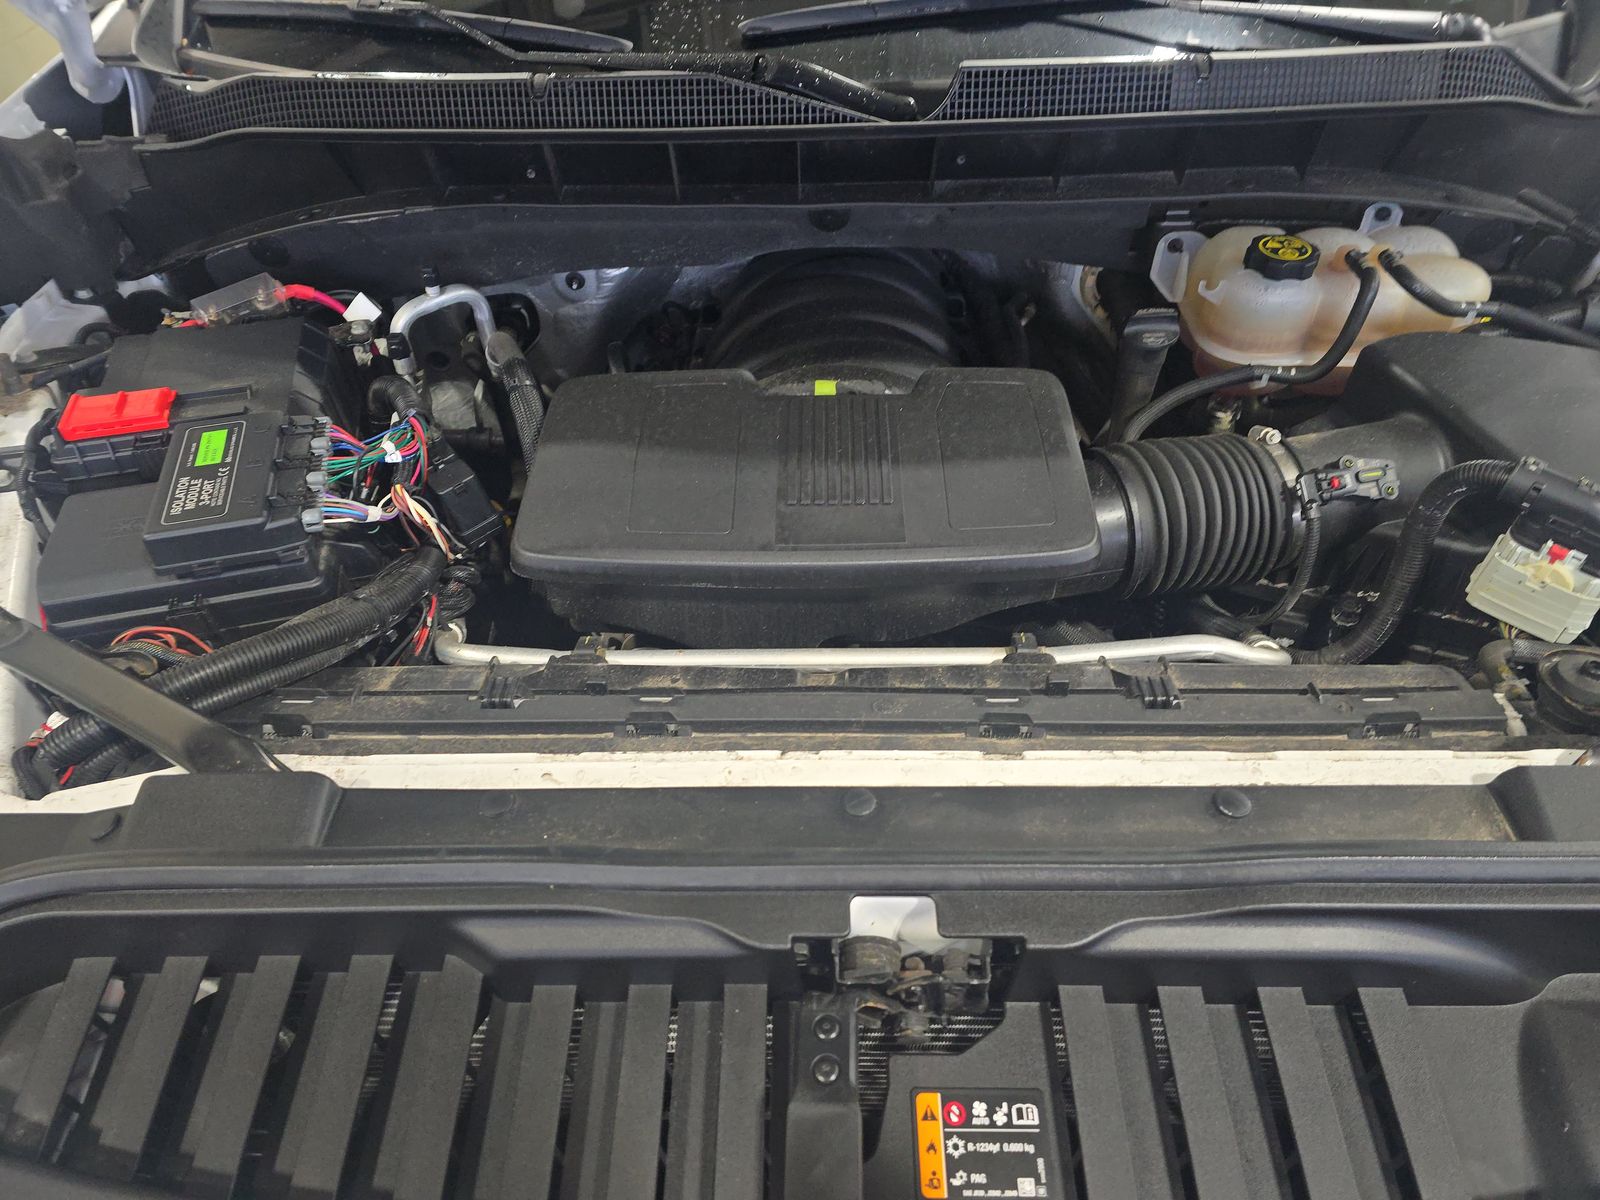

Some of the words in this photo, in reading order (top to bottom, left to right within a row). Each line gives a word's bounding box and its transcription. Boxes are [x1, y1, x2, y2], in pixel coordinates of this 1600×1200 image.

[169, 476, 191, 515] ISOLATION
[184, 478, 202, 510] MODULE
[199, 479, 215, 506] 3-PORT
[972, 1117, 990, 1125] AUTO
[1024, 1142, 1035, 1154] kg
[970, 1173, 987, 1184] PAG
